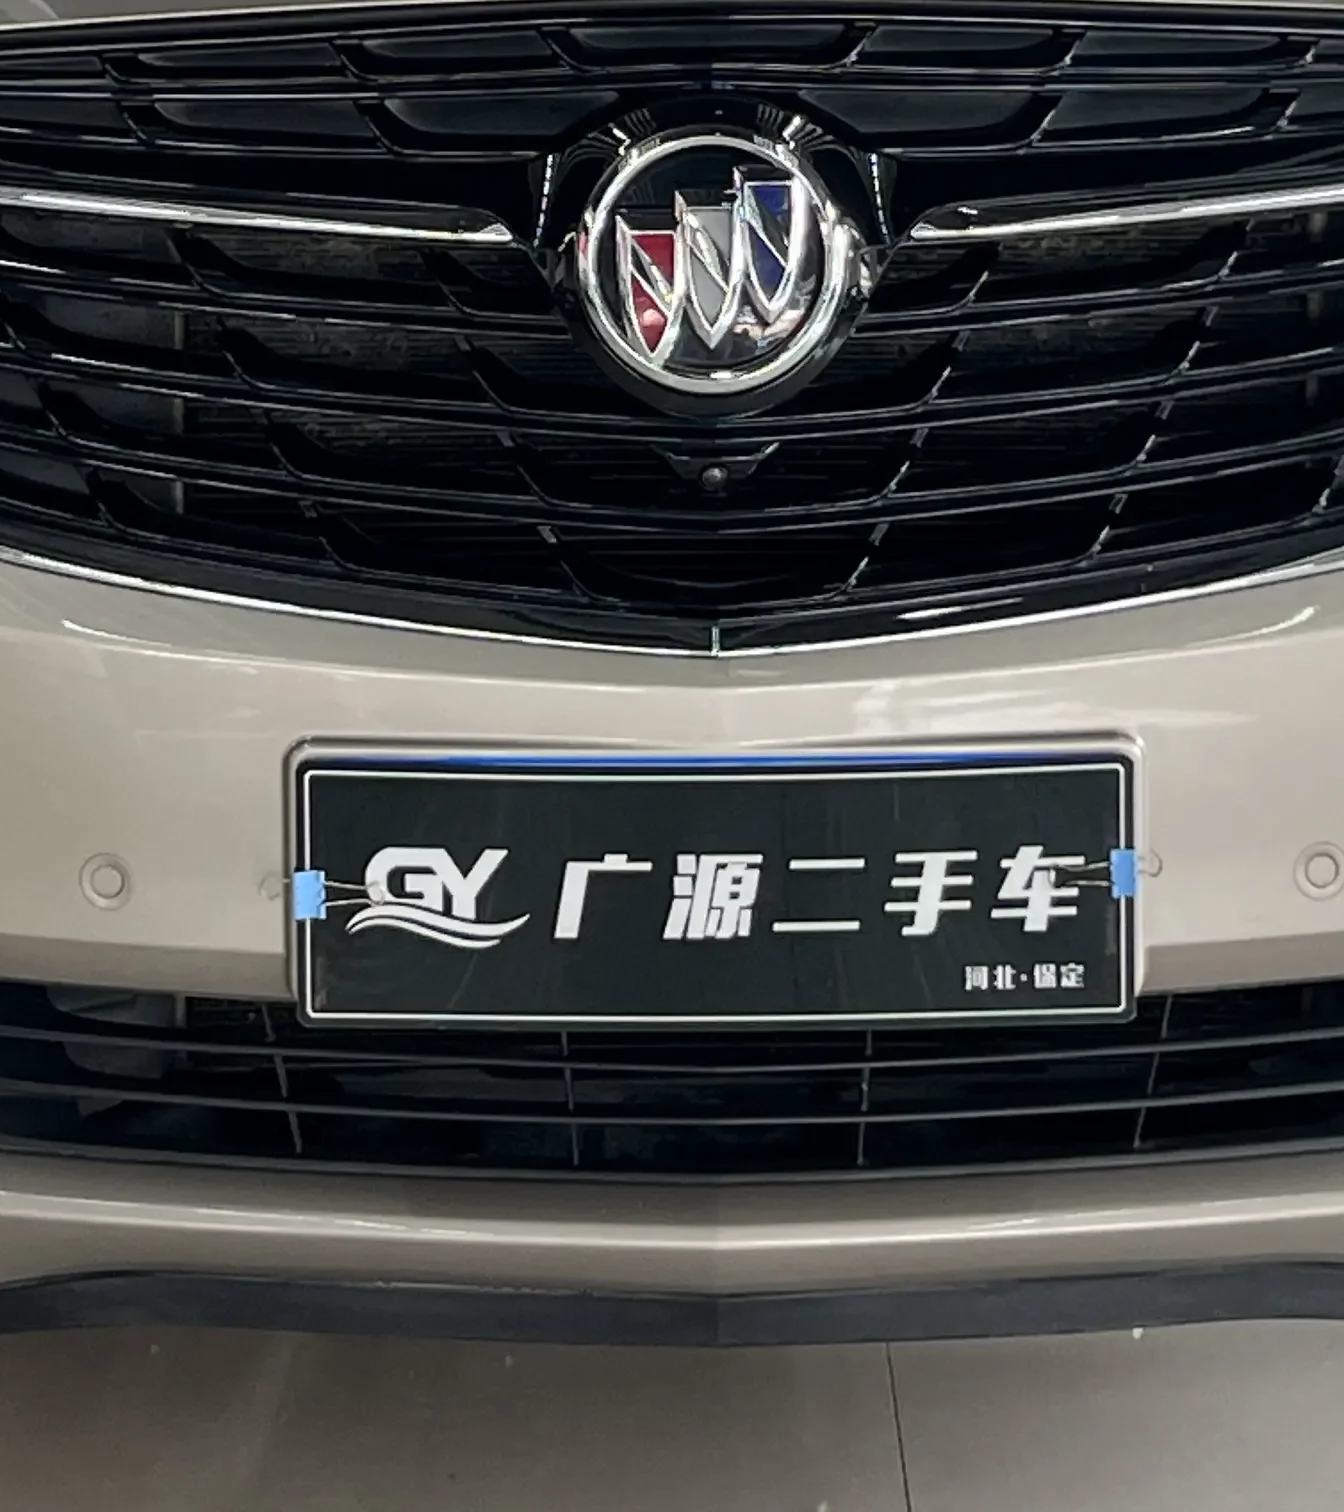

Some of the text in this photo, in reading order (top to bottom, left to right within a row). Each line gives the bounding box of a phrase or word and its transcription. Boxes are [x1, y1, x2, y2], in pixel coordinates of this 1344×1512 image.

[365, 845, 1086, 940] GY 广源二手车
